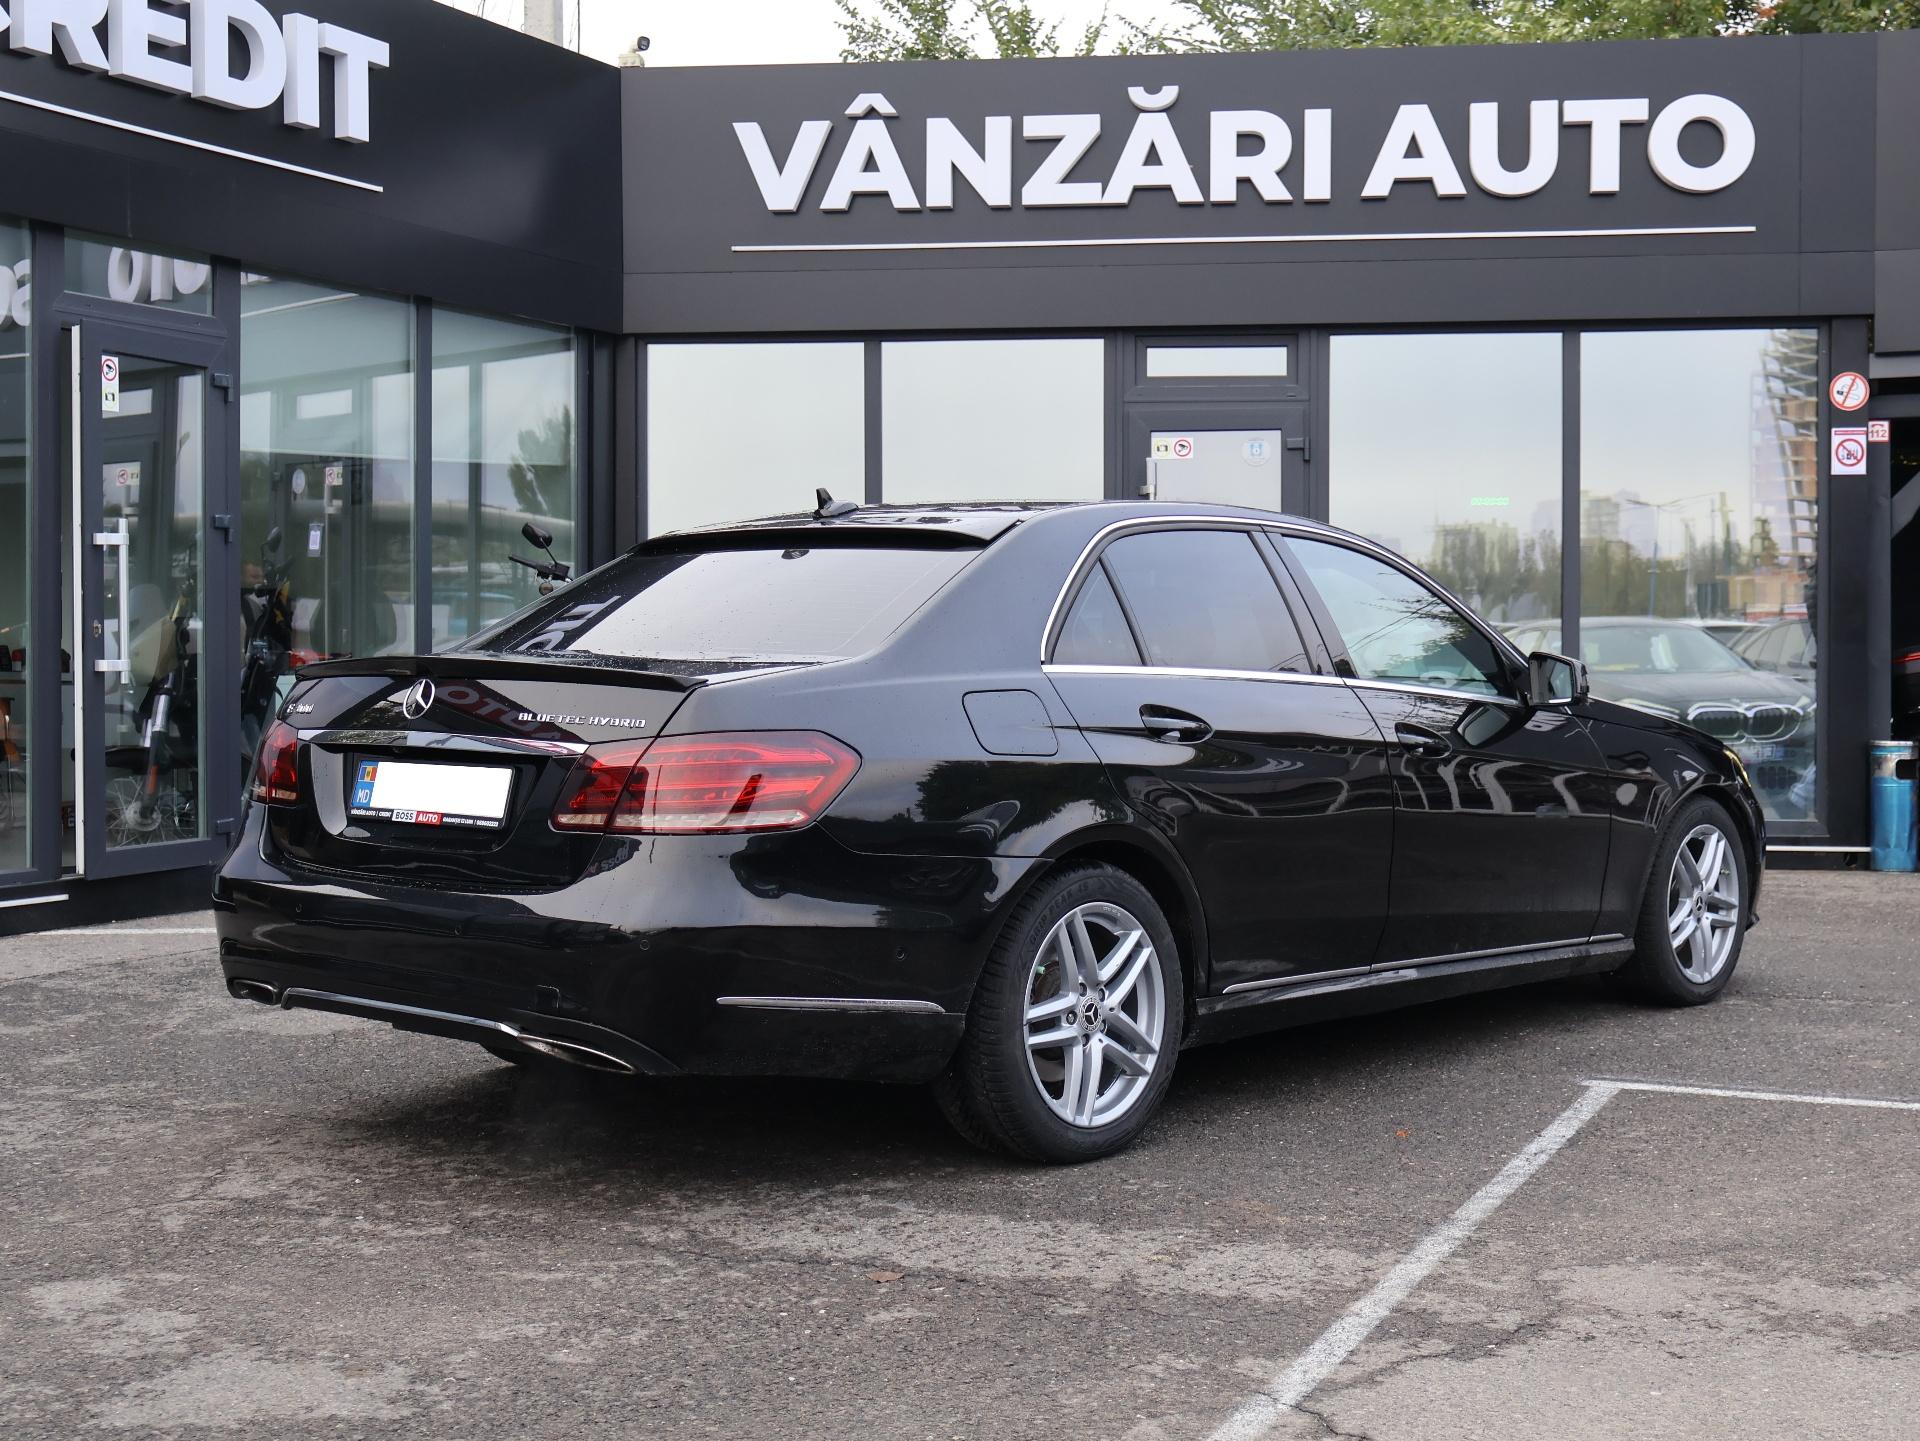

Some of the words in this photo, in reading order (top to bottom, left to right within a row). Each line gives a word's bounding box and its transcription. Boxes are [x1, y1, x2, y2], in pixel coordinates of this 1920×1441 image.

[732, 85, 1333, 213] VÂNZĂRI
[1361, 94, 1756, 199] AUTO
[1869, 429, 1887, 437] 112
[518, 712, 586, 725] BLUETEC
[588, 716, 646, 728] HYBRID
[356, 788, 370, 803] MD
[395, 811, 414, 821] BOSS
[417, 813, 438, 823] AUTO
